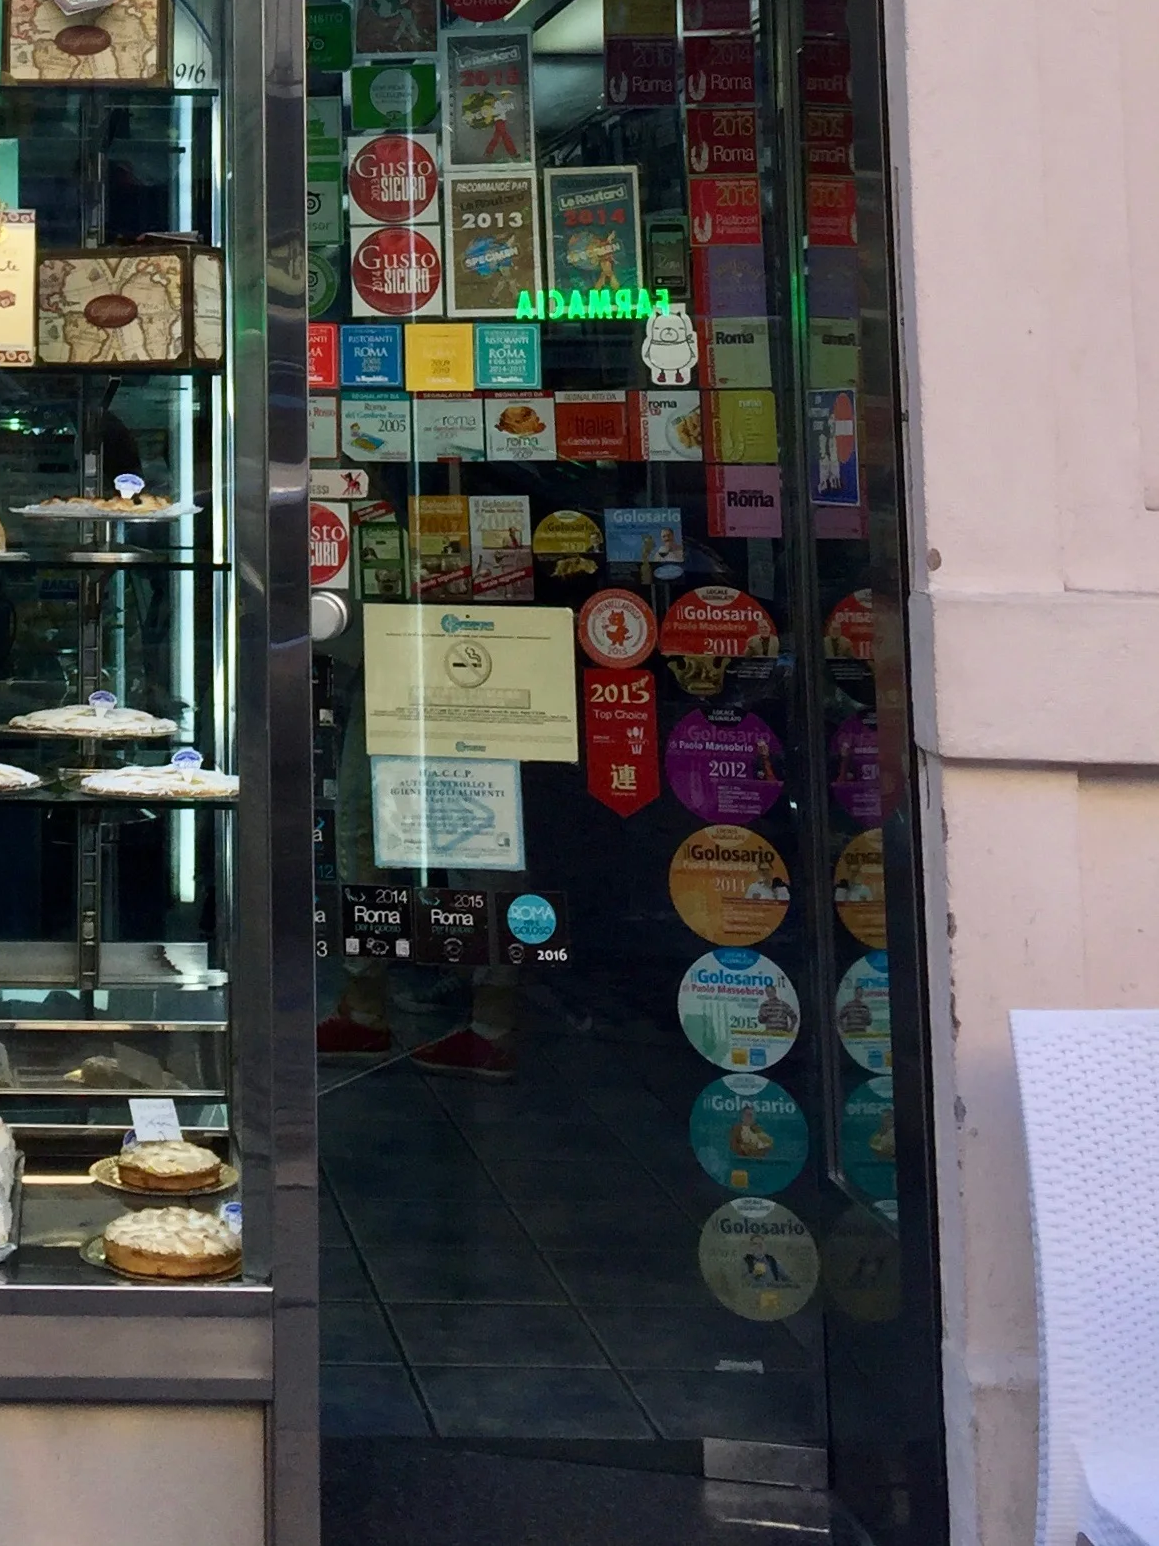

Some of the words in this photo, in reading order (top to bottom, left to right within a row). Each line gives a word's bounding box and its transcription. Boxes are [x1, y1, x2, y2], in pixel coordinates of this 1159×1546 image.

[632, 76, 673, 93] Roma
[710, 74, 752, 90] Roma
[713, 116, 754, 137] 2013
[713, 145, 755, 162] Roma
[355, 154, 433, 179] Gusto
[381, 176, 427, 202] SICURO
[716, 185, 757, 206] 2013
[560, 196, 576, 208] Le
[575, 187, 625, 204] Routard
[462, 212, 524, 229] 2013
[563, 208, 626, 227] 2014
[358, 245, 436, 270] Gusto
[384, 268, 430, 294] SICURO
[485, 336, 529, 344] RISTORANTI
[715, 331, 755, 345] Roma
[354, 347, 389, 358] ROMA
[488, 348, 527, 359] ROMA
[648, 400, 678, 409] roma
[378, 419, 406, 432] 2005
[442, 415, 476, 426] roma
[506, 437, 539, 447] roma
[726, 491, 775, 509] Roma
[612, 510, 681, 524] Golosario
[703, 638, 738, 655] 2011
[590, 676, 650, 704] 2015
[594, 710, 612, 721] Top
[614, 710, 649, 720] Choice
[679, 740, 703, 750] Paolo
[705, 741, 754, 753] Massobrio
[708, 760, 747, 778] 2012
[399, 780, 486, 789] AUTCONTROLLO
[610, 763, 637, 791] 連
[455, 789, 505, 798] ALIMENTI
[375, 890, 408, 904] 2014
[453, 894, 484, 908] 2015
[354, 906, 401, 924] Roma
[431, 910, 474, 926] Roma
[510, 906, 553, 920] ROMA
[513, 925, 551, 935] GOLOSO
[537, 949, 568, 961] 2016
[691, 984, 716, 994] Paolo
[717, 985, 765, 996] Massobrio
[729, 1015, 758, 1030] 2015
